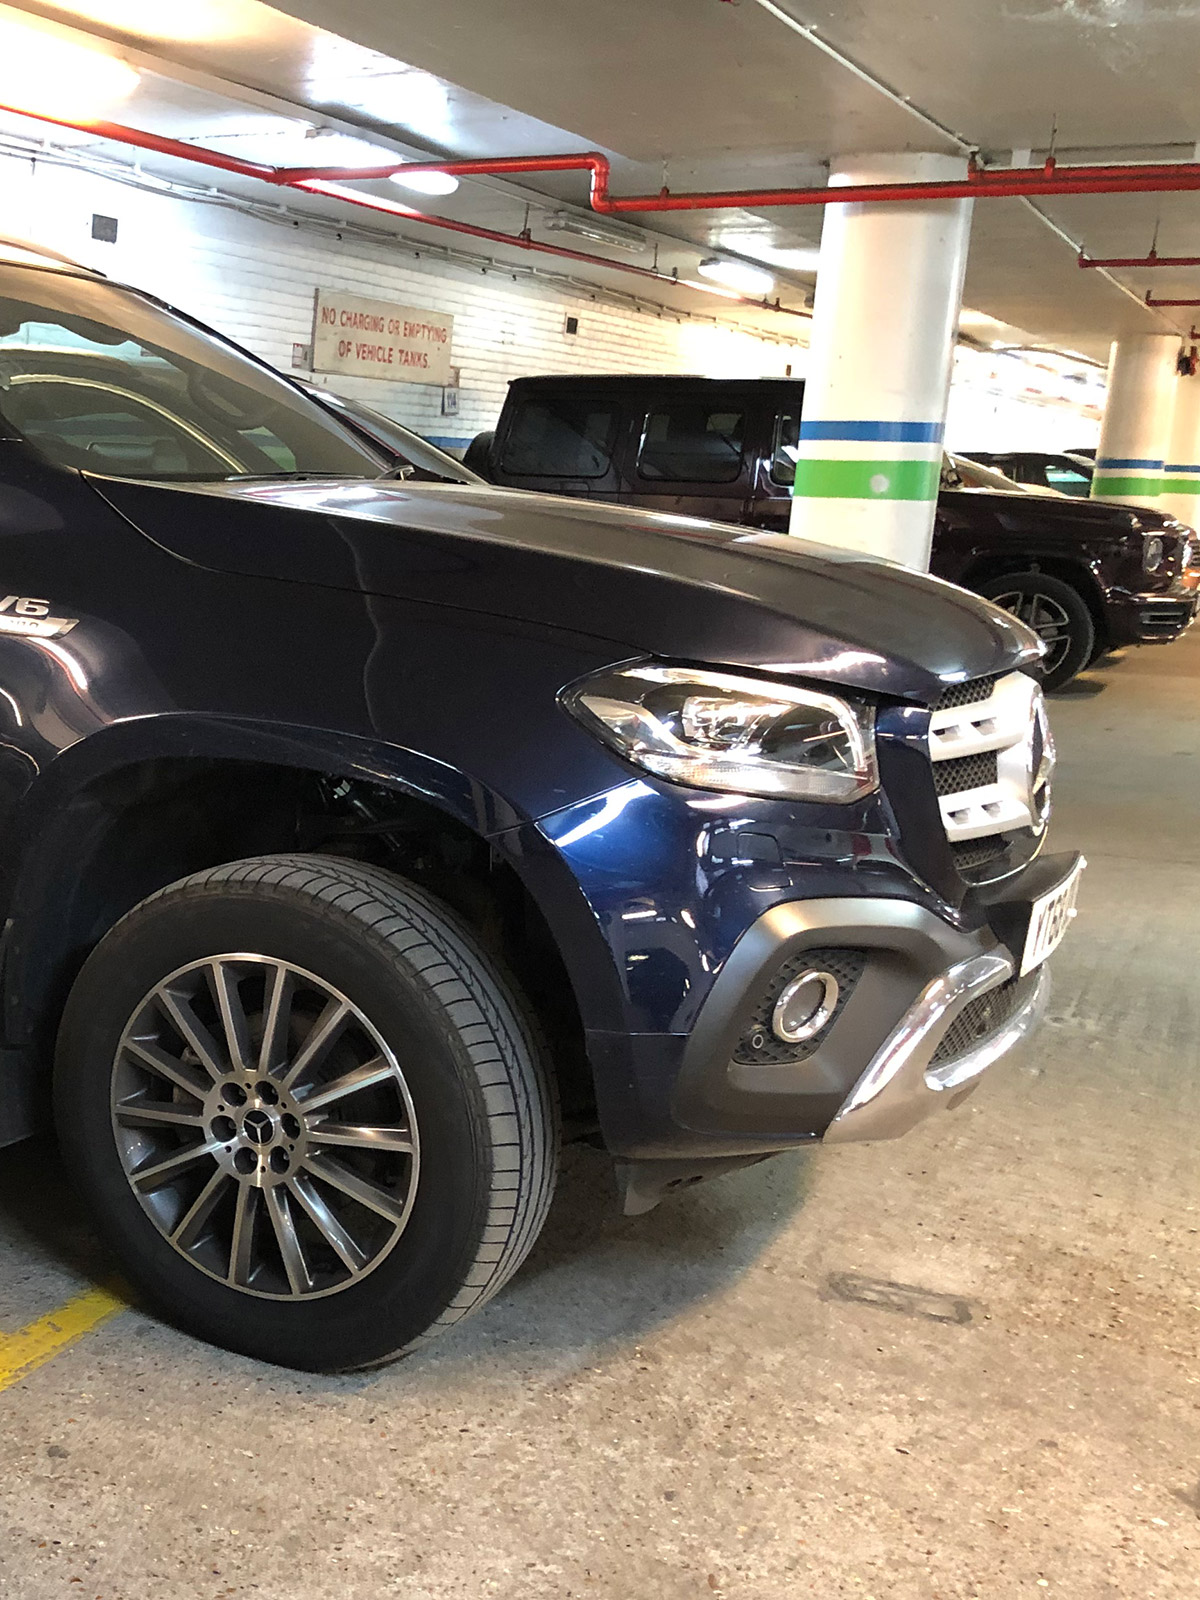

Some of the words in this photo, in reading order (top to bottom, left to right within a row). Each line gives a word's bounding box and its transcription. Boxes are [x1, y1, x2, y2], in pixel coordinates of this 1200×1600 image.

[321, 306, 337, 325] NO
[339, 310, 385, 333] CHARGING
[388, 318, 400, 337] OR
[403, 321, 448, 344] EMPTYING
[338, 340, 352, 358] OF
[355, 342, 393, 364] VEHICLE
[398, 349, 431, 369] TANKS.
